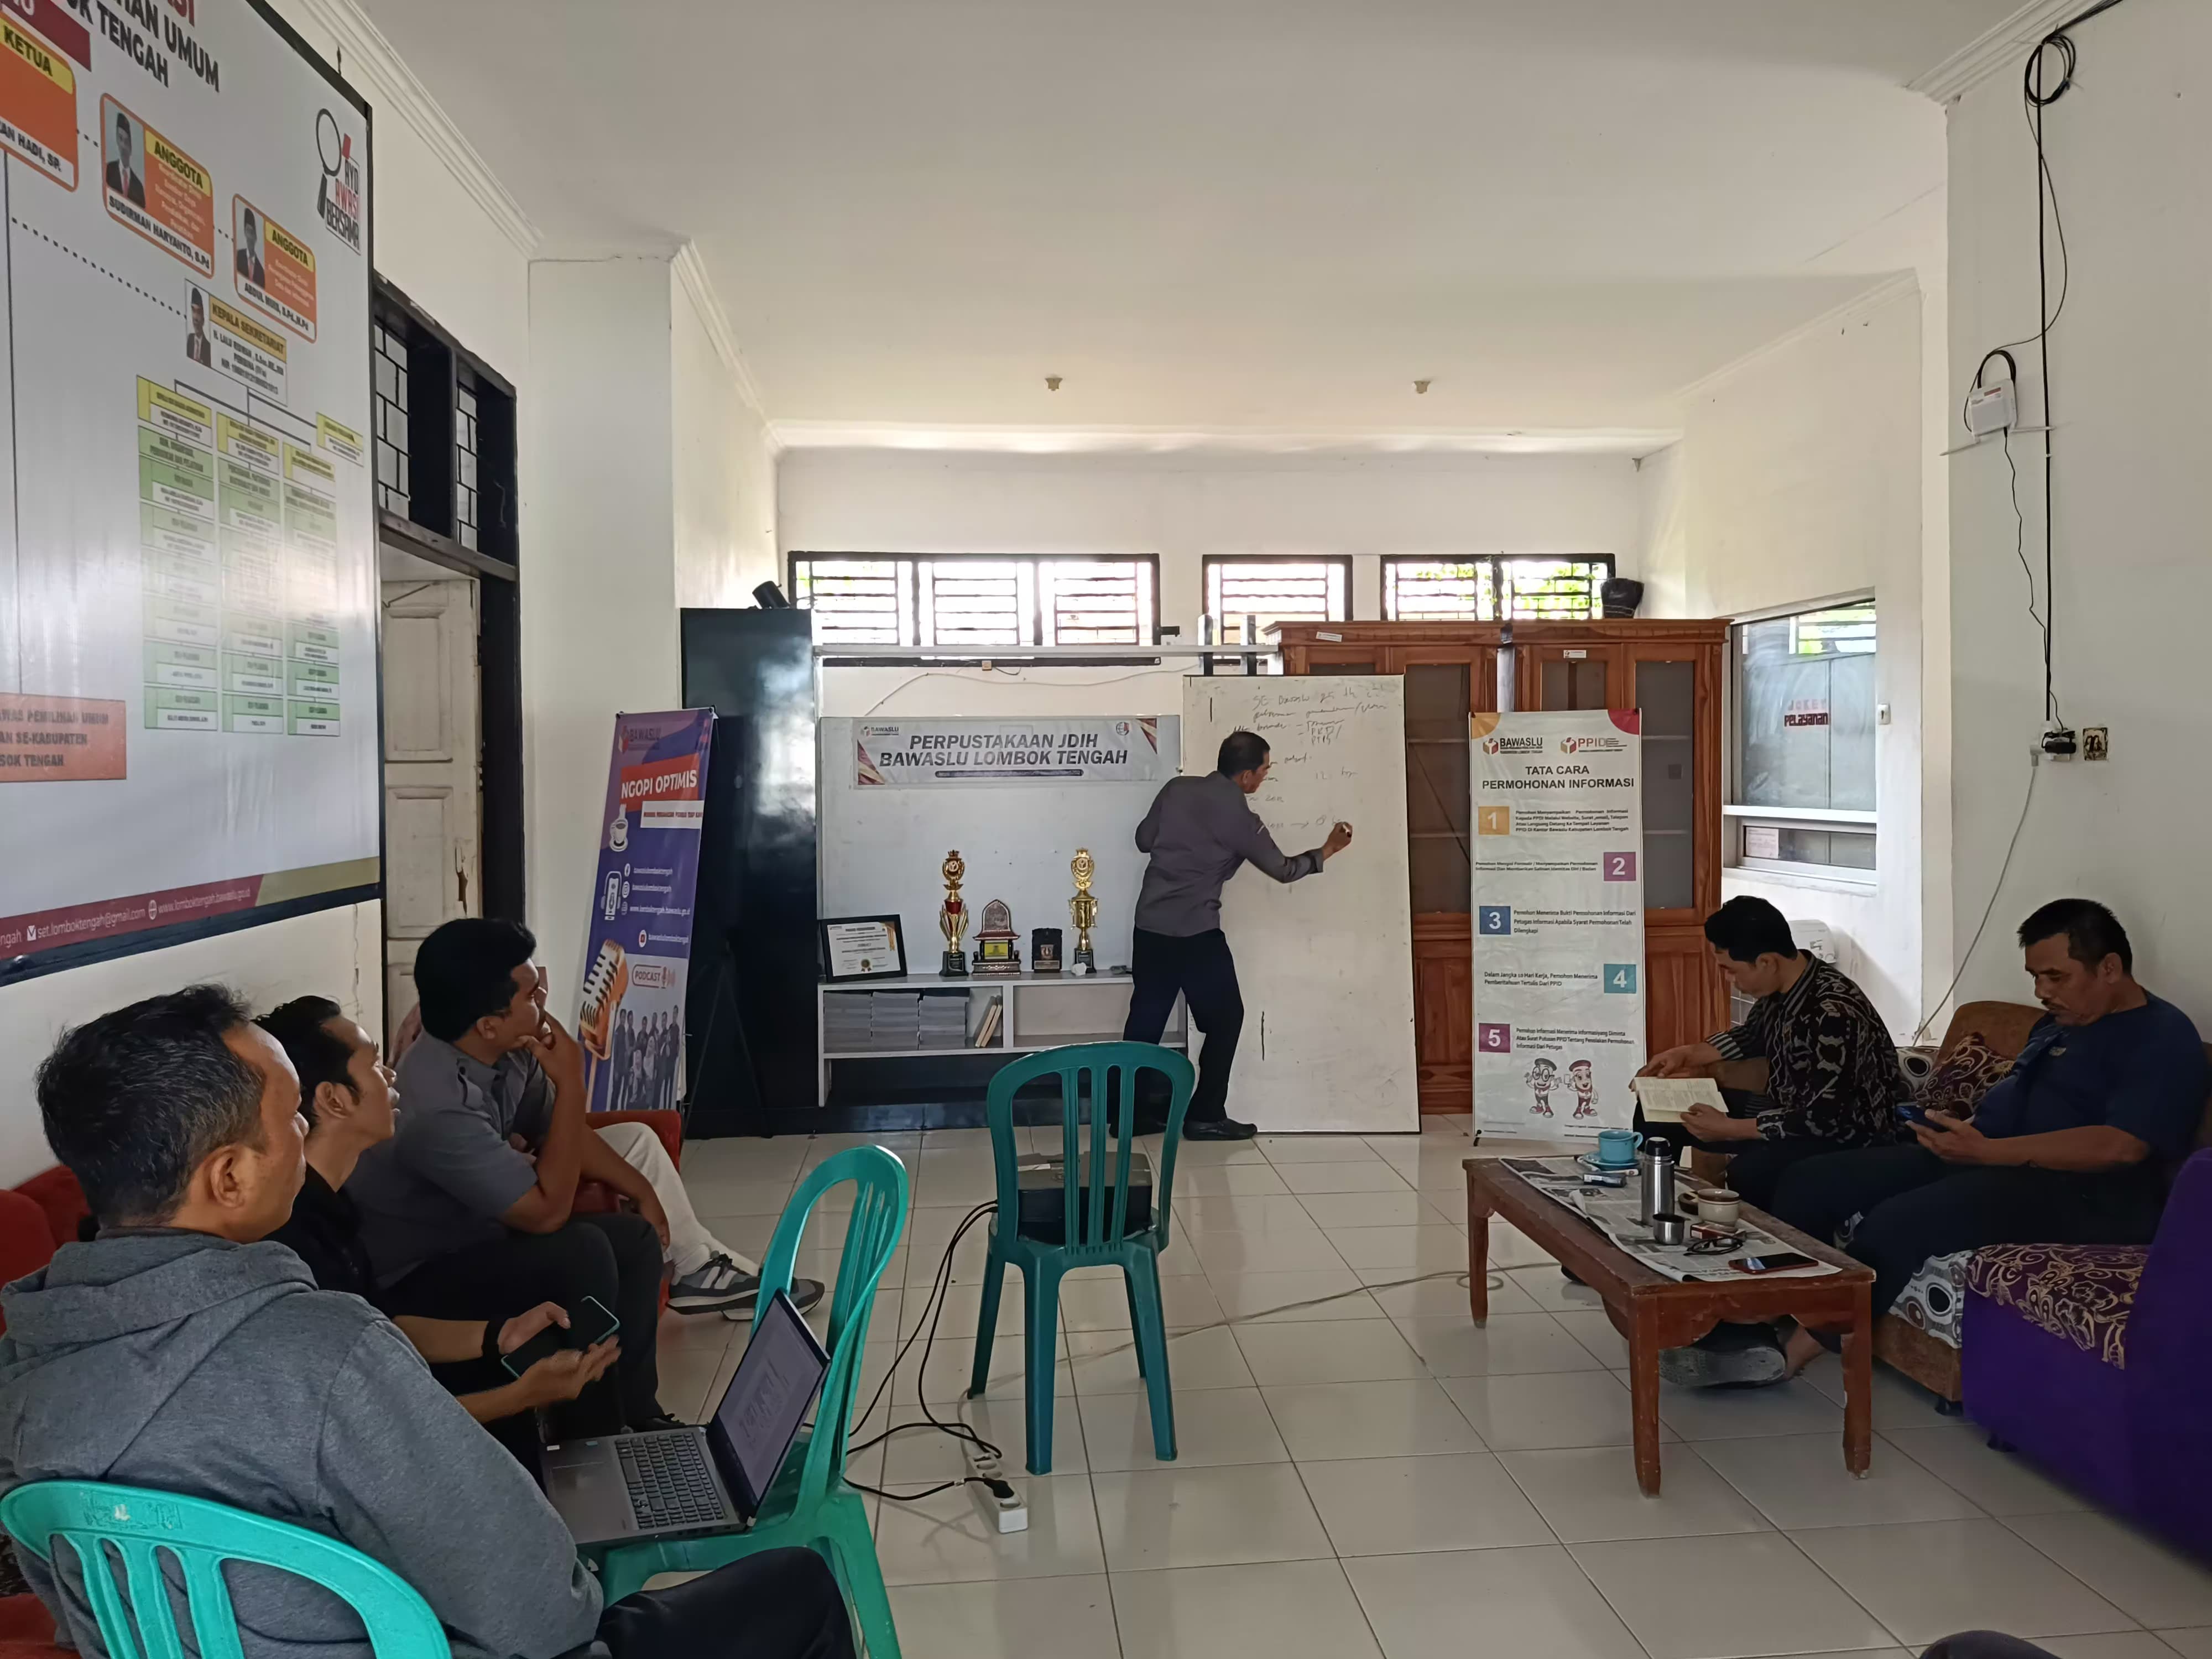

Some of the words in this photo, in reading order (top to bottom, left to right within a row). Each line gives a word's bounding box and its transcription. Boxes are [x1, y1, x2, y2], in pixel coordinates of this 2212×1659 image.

[4, 25, 54, 76] KETUA
[96, 0, 169, 88] TENGAH
[164, 14, 220, 93] UMUM
[154, 140, 204, 189] ANGGOTA
[272, 229, 309, 267] ANGGOTA
[16, 732, 88, 745] SE-KABUPATEN
[909, 733, 1054, 749] PERPUSTAKAAN
[1057, 733, 1098, 748] JDIH
[1499, 737, 1543, 747] BAWASLU
[24, 754, 64, 767] TENGAH
[879, 751, 969, 766] BAWASLU
[973, 750, 1051, 765] LOMBOK
[1057, 750, 1128, 764] TENGAH
[1525, 765, 1553, 775] TATA
[1556, 765, 1590, 775] CARA
[621, 778, 654, 800] NGOPI
[655, 769, 698, 794] OPTIMIS
[1482, 779, 1566, 790] PERMOHONAN
[1569, 778, 1634, 789] INFORMASI
[1488, 811, 1498, 830] 1
[1612, 858, 1625, 875] 2
[1489, 912, 1501, 930] 3
[635, 970, 661, 982] PODCAST
[1613, 969, 1627, 988] 4
[1488, 1029, 1501, 1047] 5
